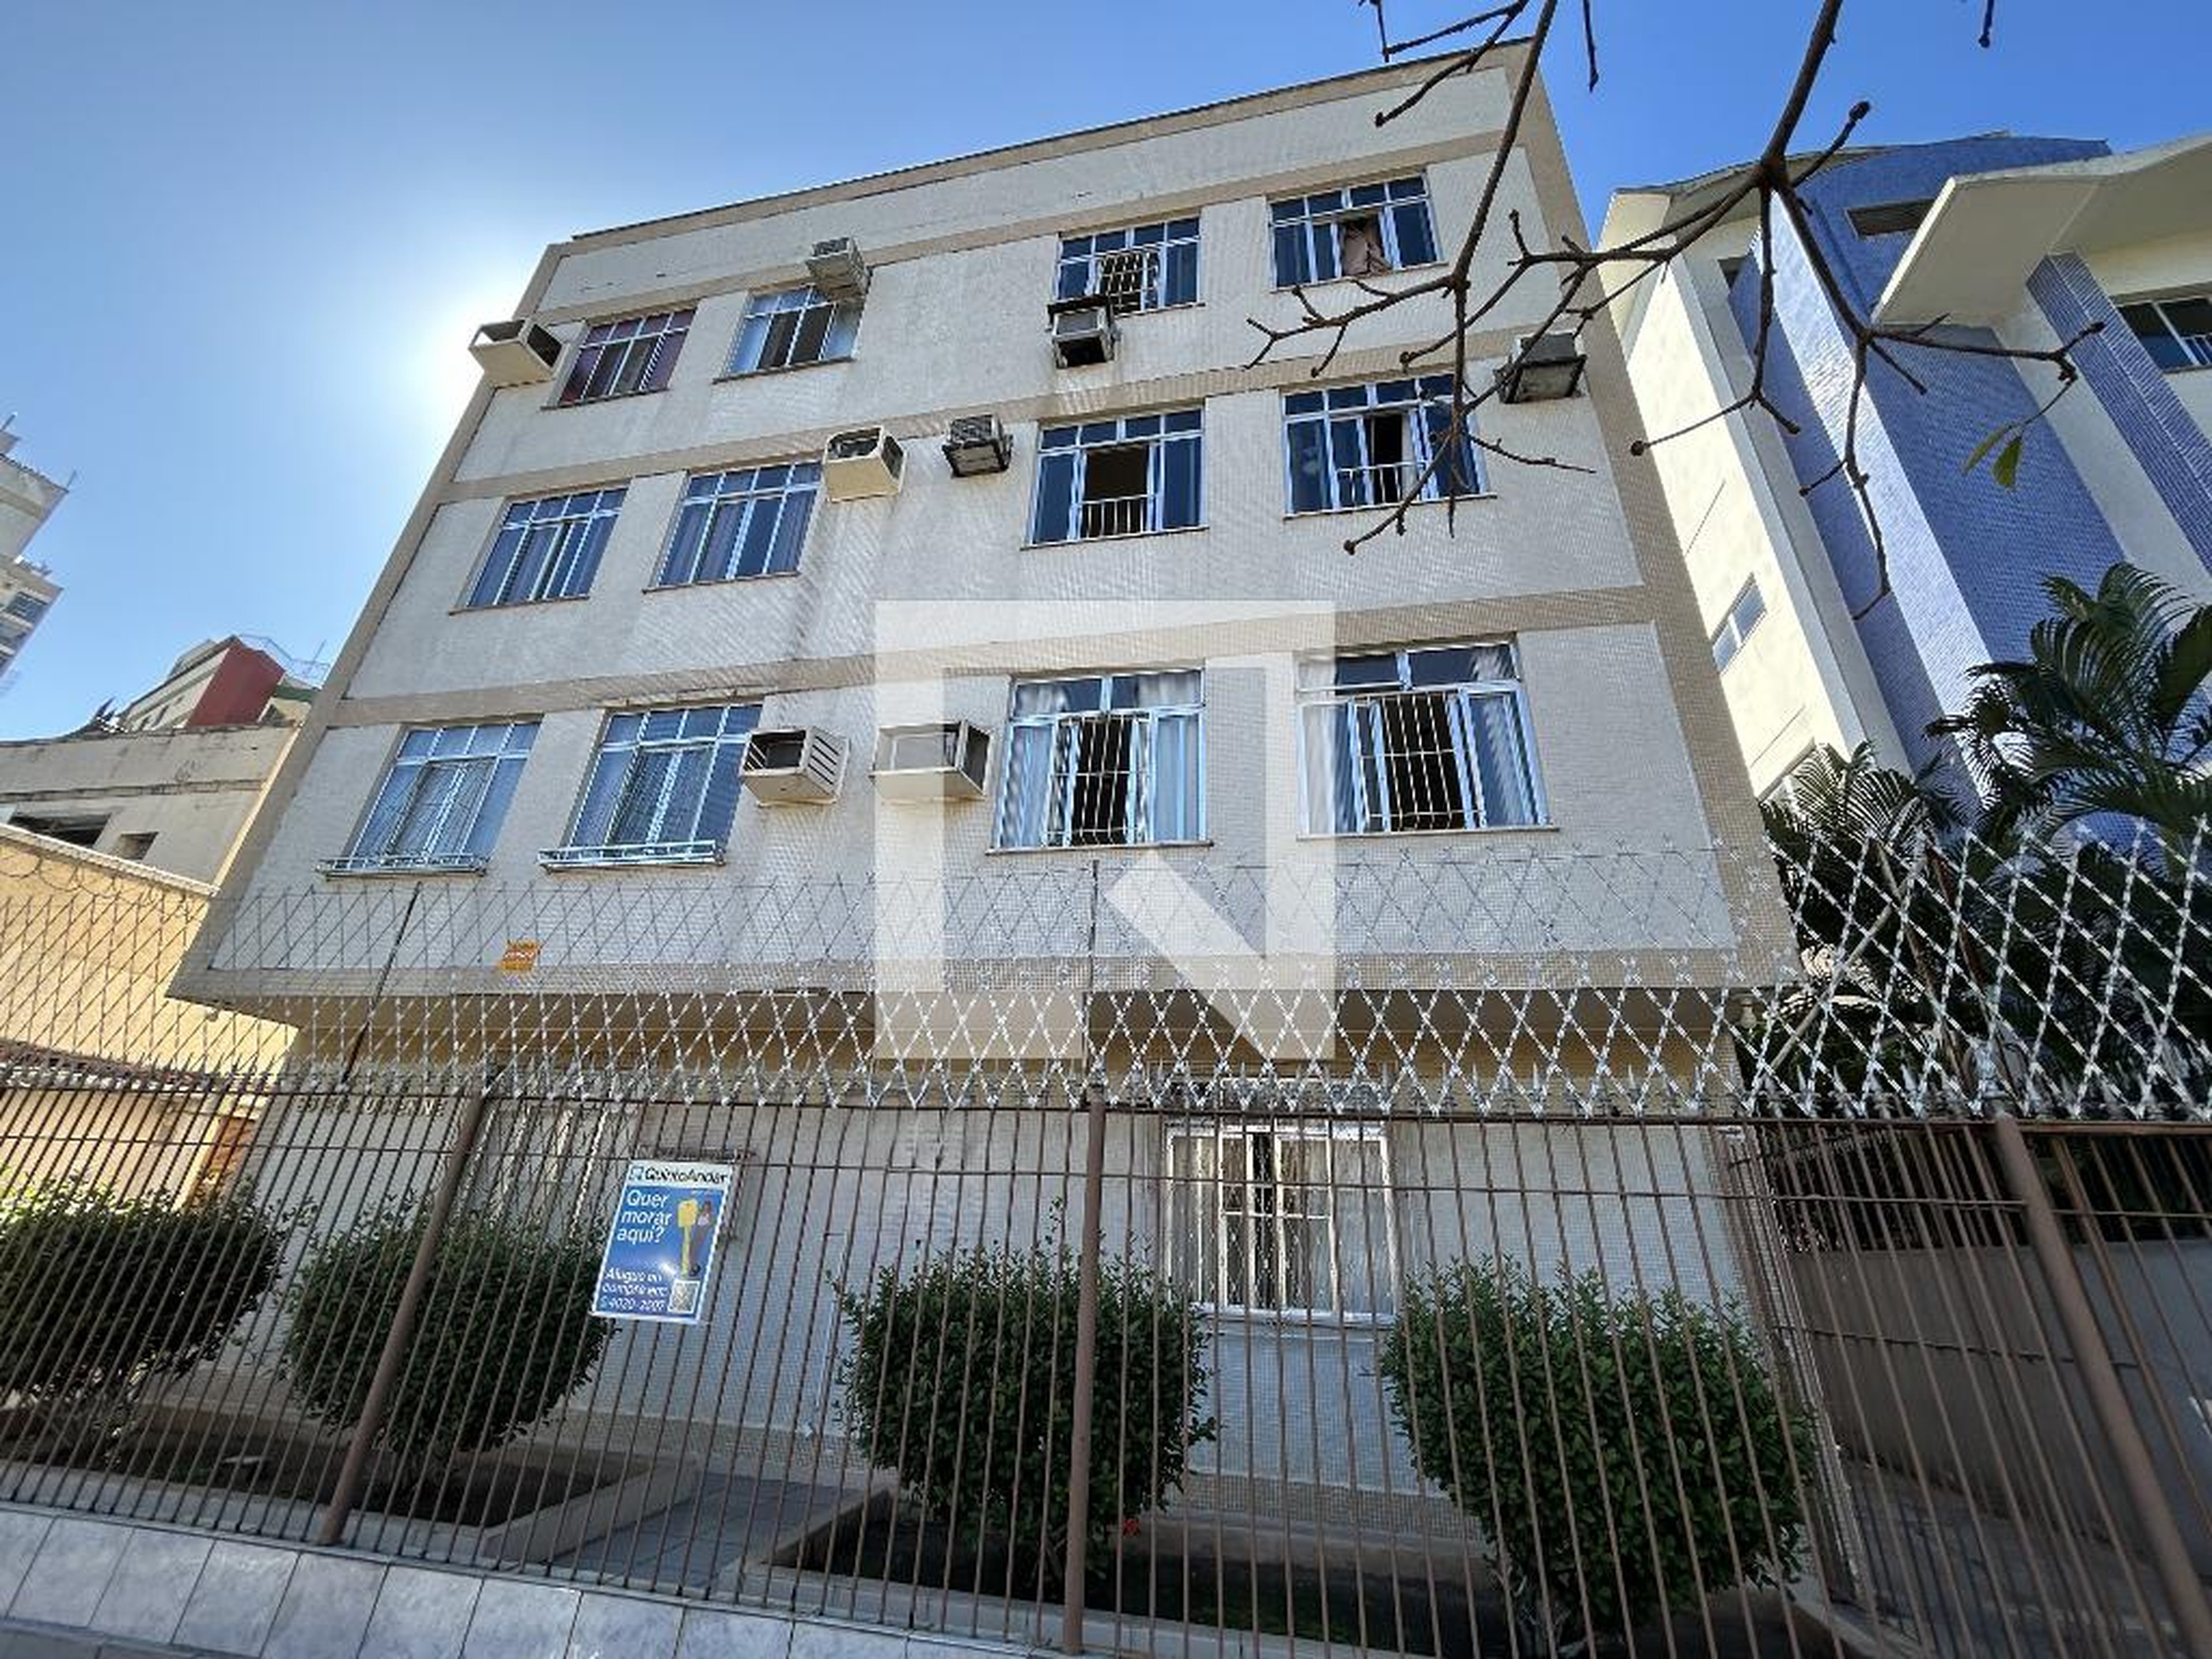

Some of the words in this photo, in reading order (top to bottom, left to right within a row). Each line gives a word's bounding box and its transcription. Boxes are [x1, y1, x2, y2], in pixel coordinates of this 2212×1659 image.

[627, 1189, 669, 1208] Quer
[622, 1211, 672, 1226] morar
[617, 1225, 665, 1245] aqui?
